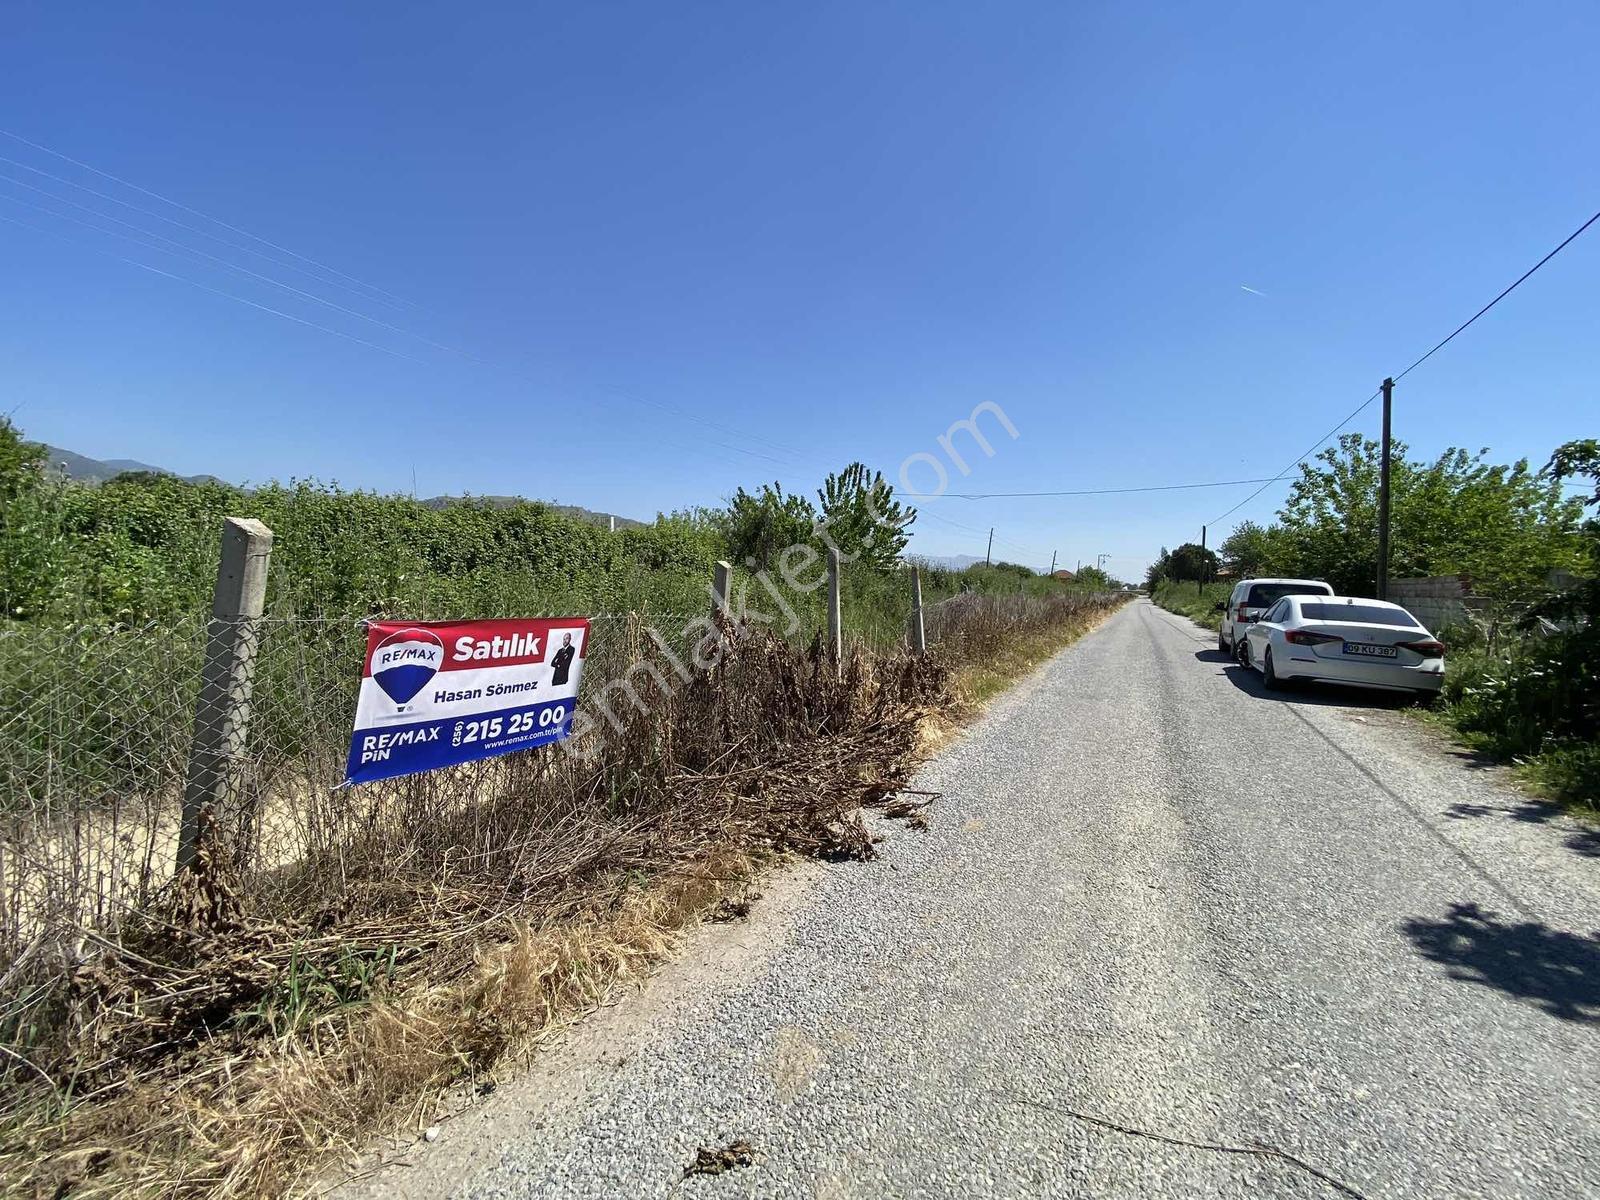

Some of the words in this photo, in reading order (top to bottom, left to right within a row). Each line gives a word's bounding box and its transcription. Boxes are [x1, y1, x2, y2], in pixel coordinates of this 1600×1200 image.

[382, 649, 436, 664] RE/MAX
[452, 632, 541, 661] Satılık
[1348, 644, 1359, 652] 09
[1362, 646, 1375, 654] KU
[434, 688, 482, 703] Hasan
[486, 681, 538, 697] Sönmez
[463, 717, 503, 743] 215
[507, 711, 534, 735] 25
[539, 705, 565, 727] 00
[363, 726, 441, 751] RE/MAX
[484, 726, 563, 750] www.remax.com.tr/pin
